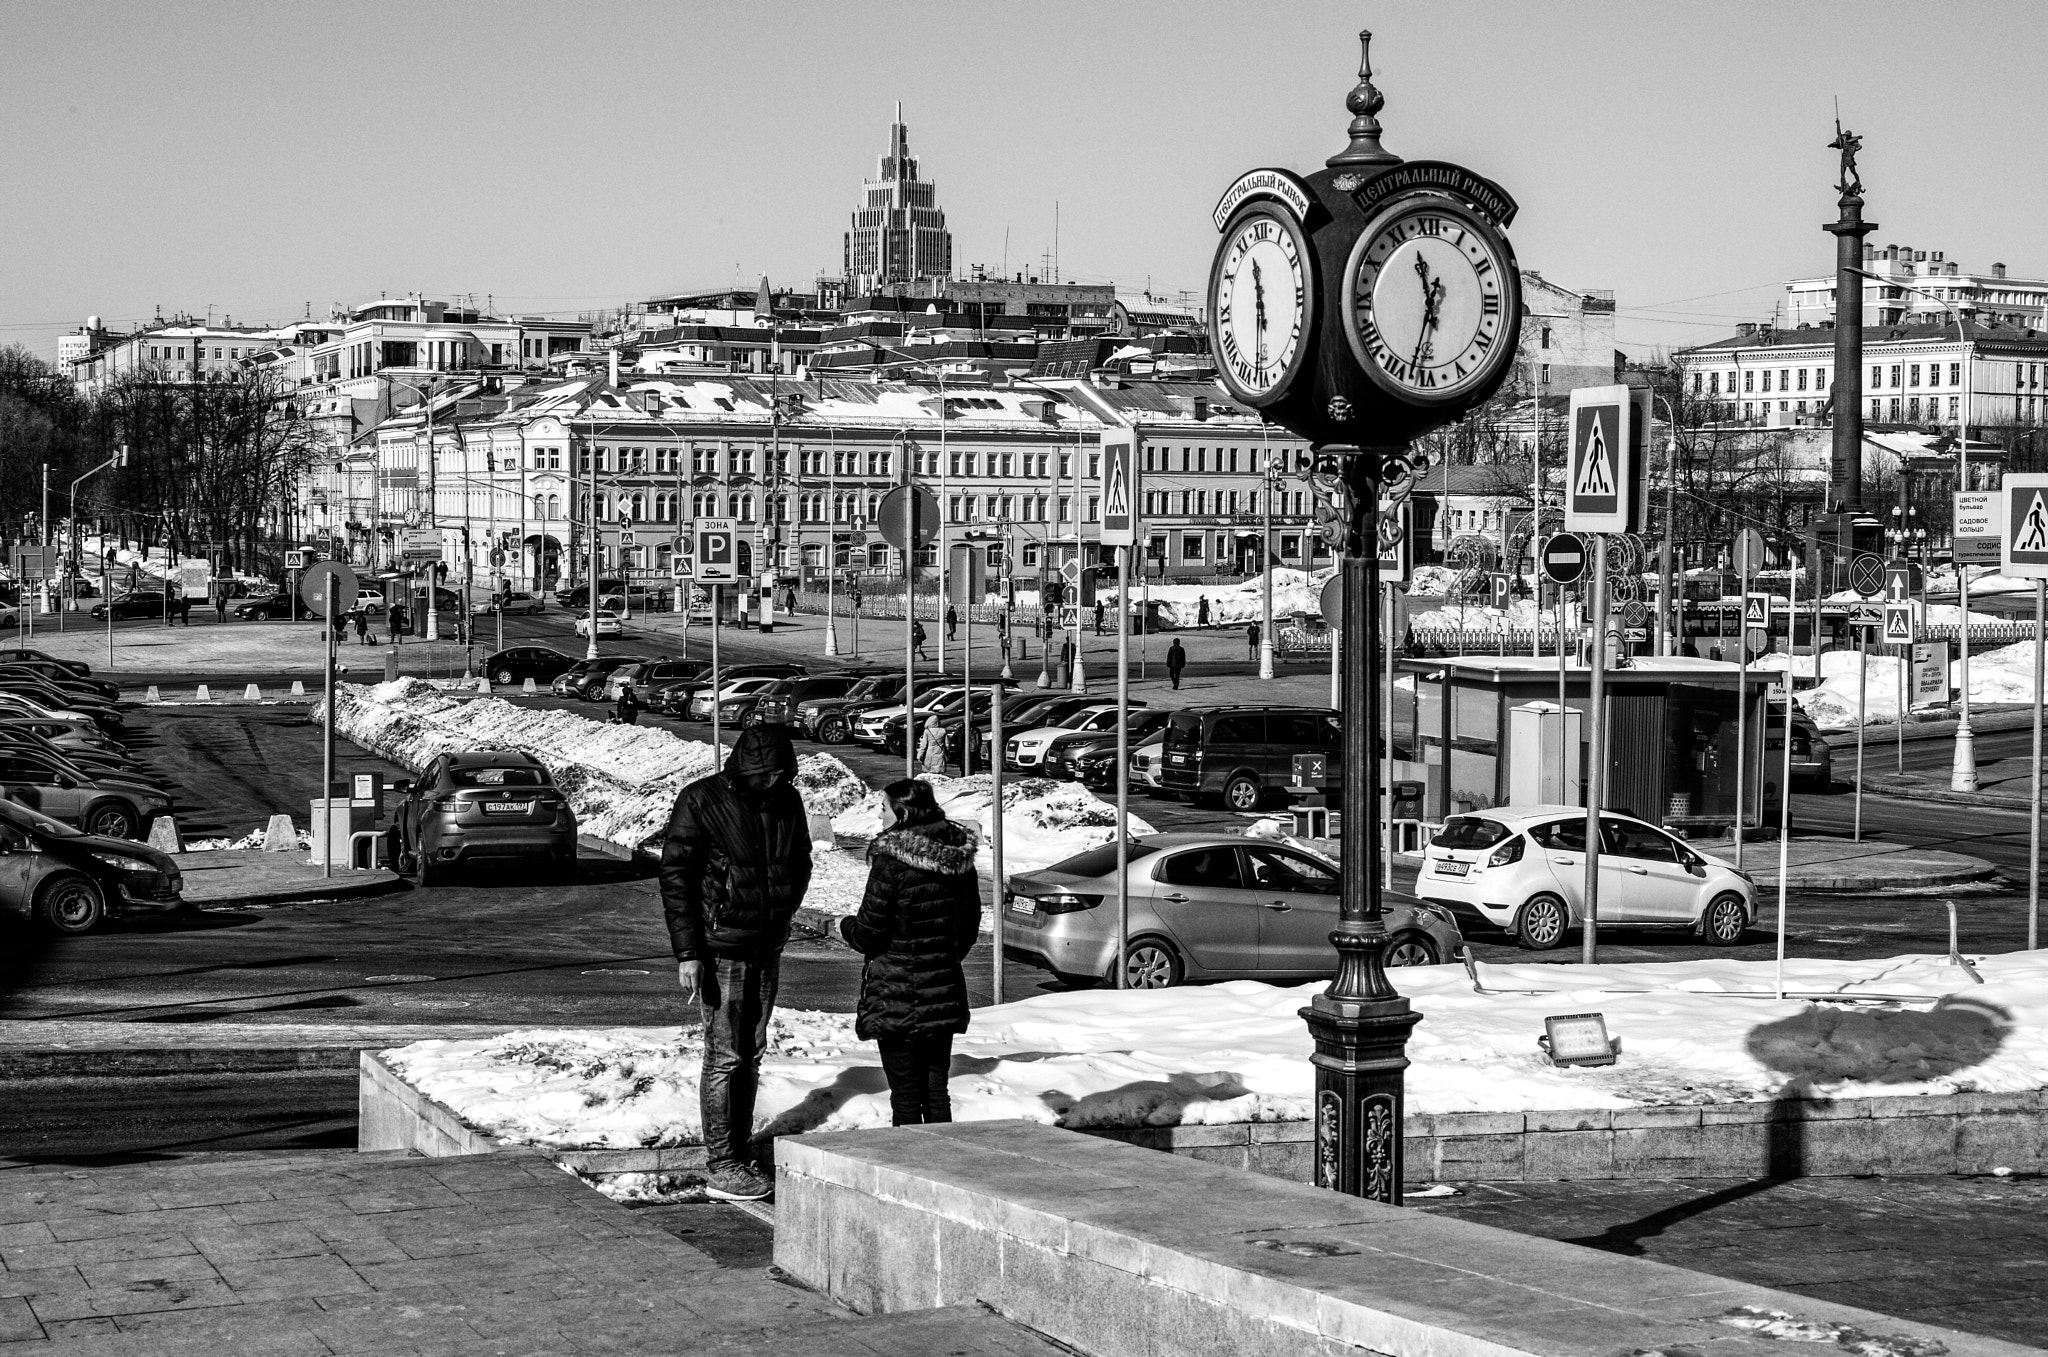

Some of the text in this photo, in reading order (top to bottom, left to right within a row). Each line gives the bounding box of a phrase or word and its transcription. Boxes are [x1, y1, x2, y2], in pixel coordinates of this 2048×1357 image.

[1216, 174, 1307, 225] ЦЕНТРАЛЬНЫЙ РЫНОК
[1357, 168, 1506, 217] ЦЕНТРАЛЬНЫЙ РЫНОК
[1417, 218, 1440, 236] XII
[704, 521, 729, 529] ЗОНА
